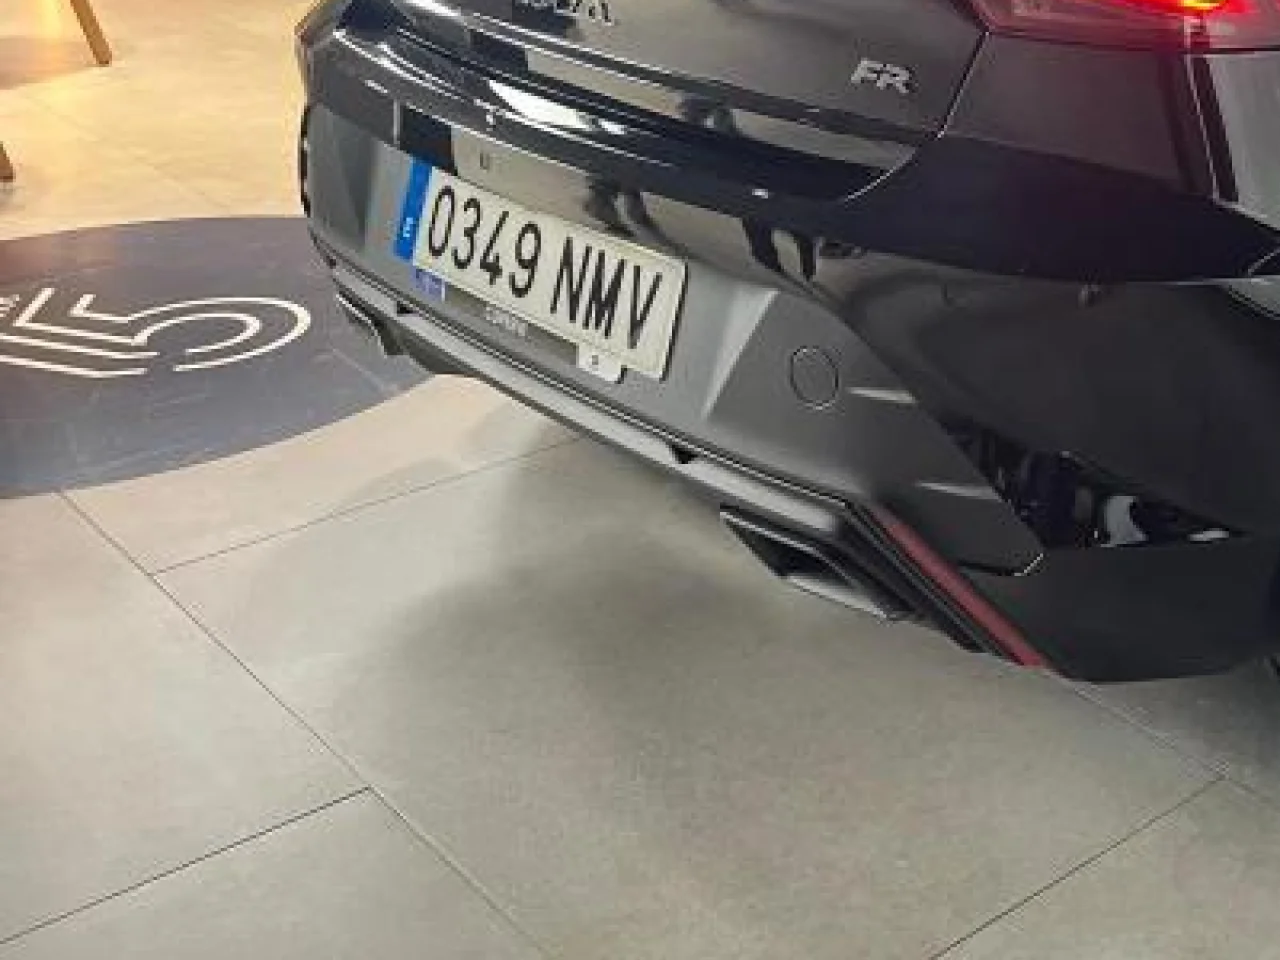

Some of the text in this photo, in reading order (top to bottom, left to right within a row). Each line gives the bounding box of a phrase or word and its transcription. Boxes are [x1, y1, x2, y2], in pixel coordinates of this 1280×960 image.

[850, 57, 912, 94] FR
[428, 185, 663, 349] 0349 NMV
